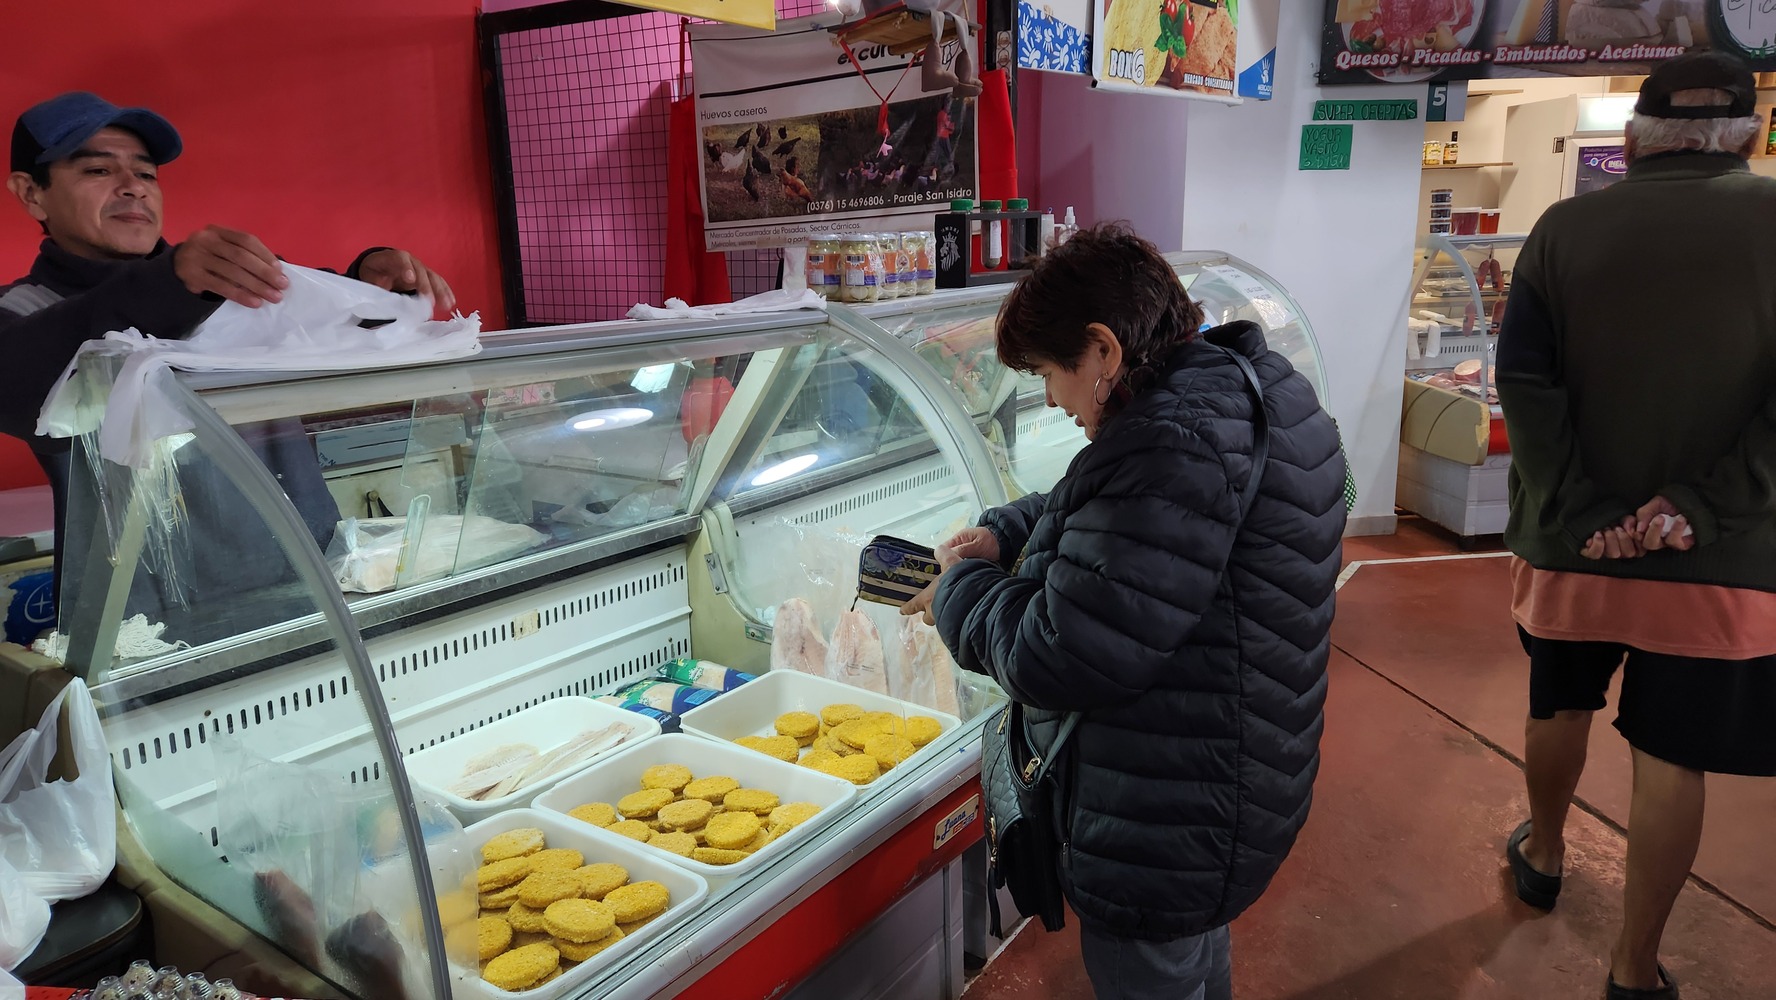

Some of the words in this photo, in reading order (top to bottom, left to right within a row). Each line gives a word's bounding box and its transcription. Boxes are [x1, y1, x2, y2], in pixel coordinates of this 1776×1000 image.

[1336, 51, 1399, 68] Quesos
[1412, 48, 1481, 65] Picadas
[1494, 45, 1587, 62] Embutidos
[1599, 43, 1685, 60] Aceitunas
[1110, 48, 1133, 79] BOX
[1131, 47, 1146, 86] 6
[1183, 72, 1204, 86] MERCADO
[1432, 86, 1447, 106] 5
[700, 110, 731, 120] Huevos
[734, 107, 768, 117] caseros
[1317, 103, 1355, 120] SUPER
[1361, 101, 1417, 120] OFERTAS
[1306, 127, 1342, 141] YOGUR
[1304, 141, 1339, 155] VASITO
[806, 200, 834, 213] (0376)
[836, 199, 847, 209] 15
[849, 195, 885, 208] 4696806
[893, 191, 924, 204] Paraje
[926, 190, 944, 201] San
[946, 187, 972, 199] Isidro
[710, 231, 735, 239] Mercado
[735, 228, 772, 238] Concentrador
[809, 224, 830, 233] Sector
